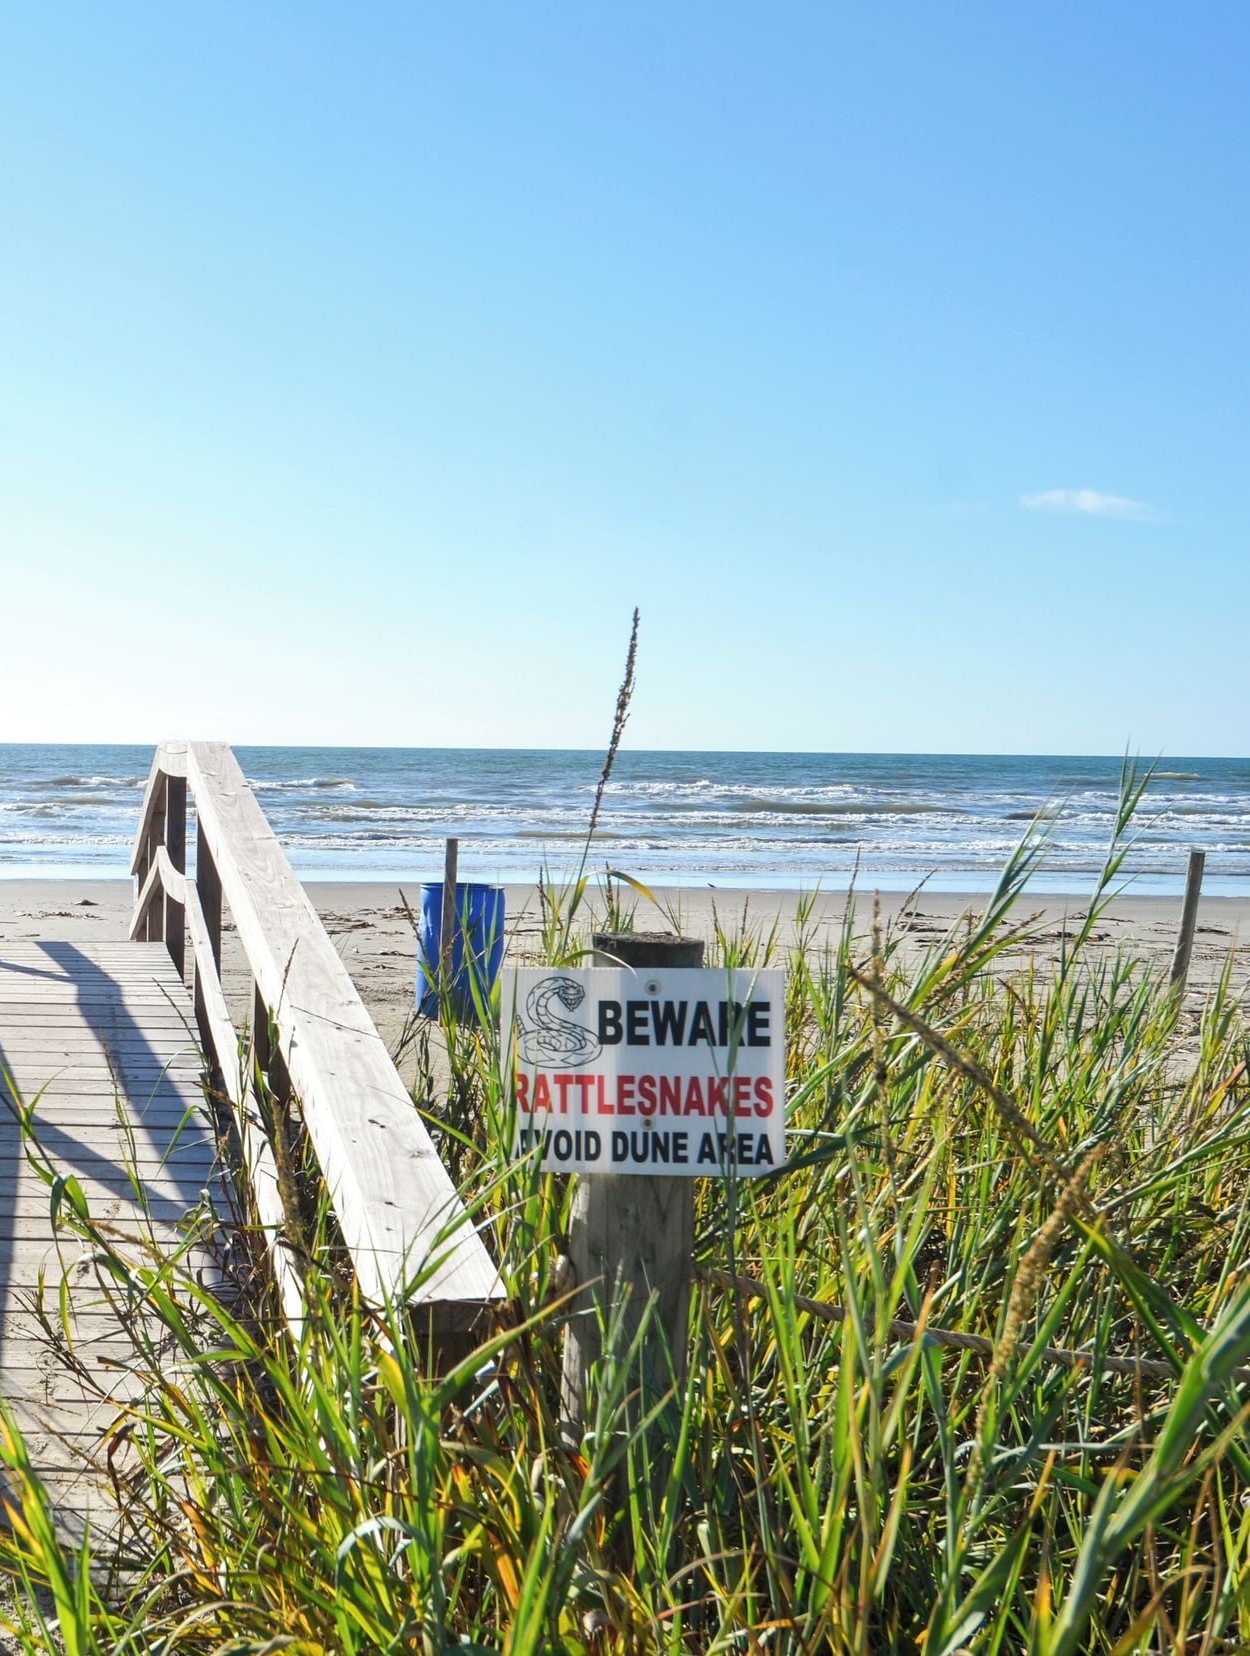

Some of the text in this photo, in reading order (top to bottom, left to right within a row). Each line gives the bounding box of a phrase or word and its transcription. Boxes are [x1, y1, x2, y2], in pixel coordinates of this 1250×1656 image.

[598, 1000, 771, 1047] BEWARE
[516, 1073, 774, 1118] RATTLESNAKES
[515, 1129, 774, 1166] AVOID DUNE AREA
